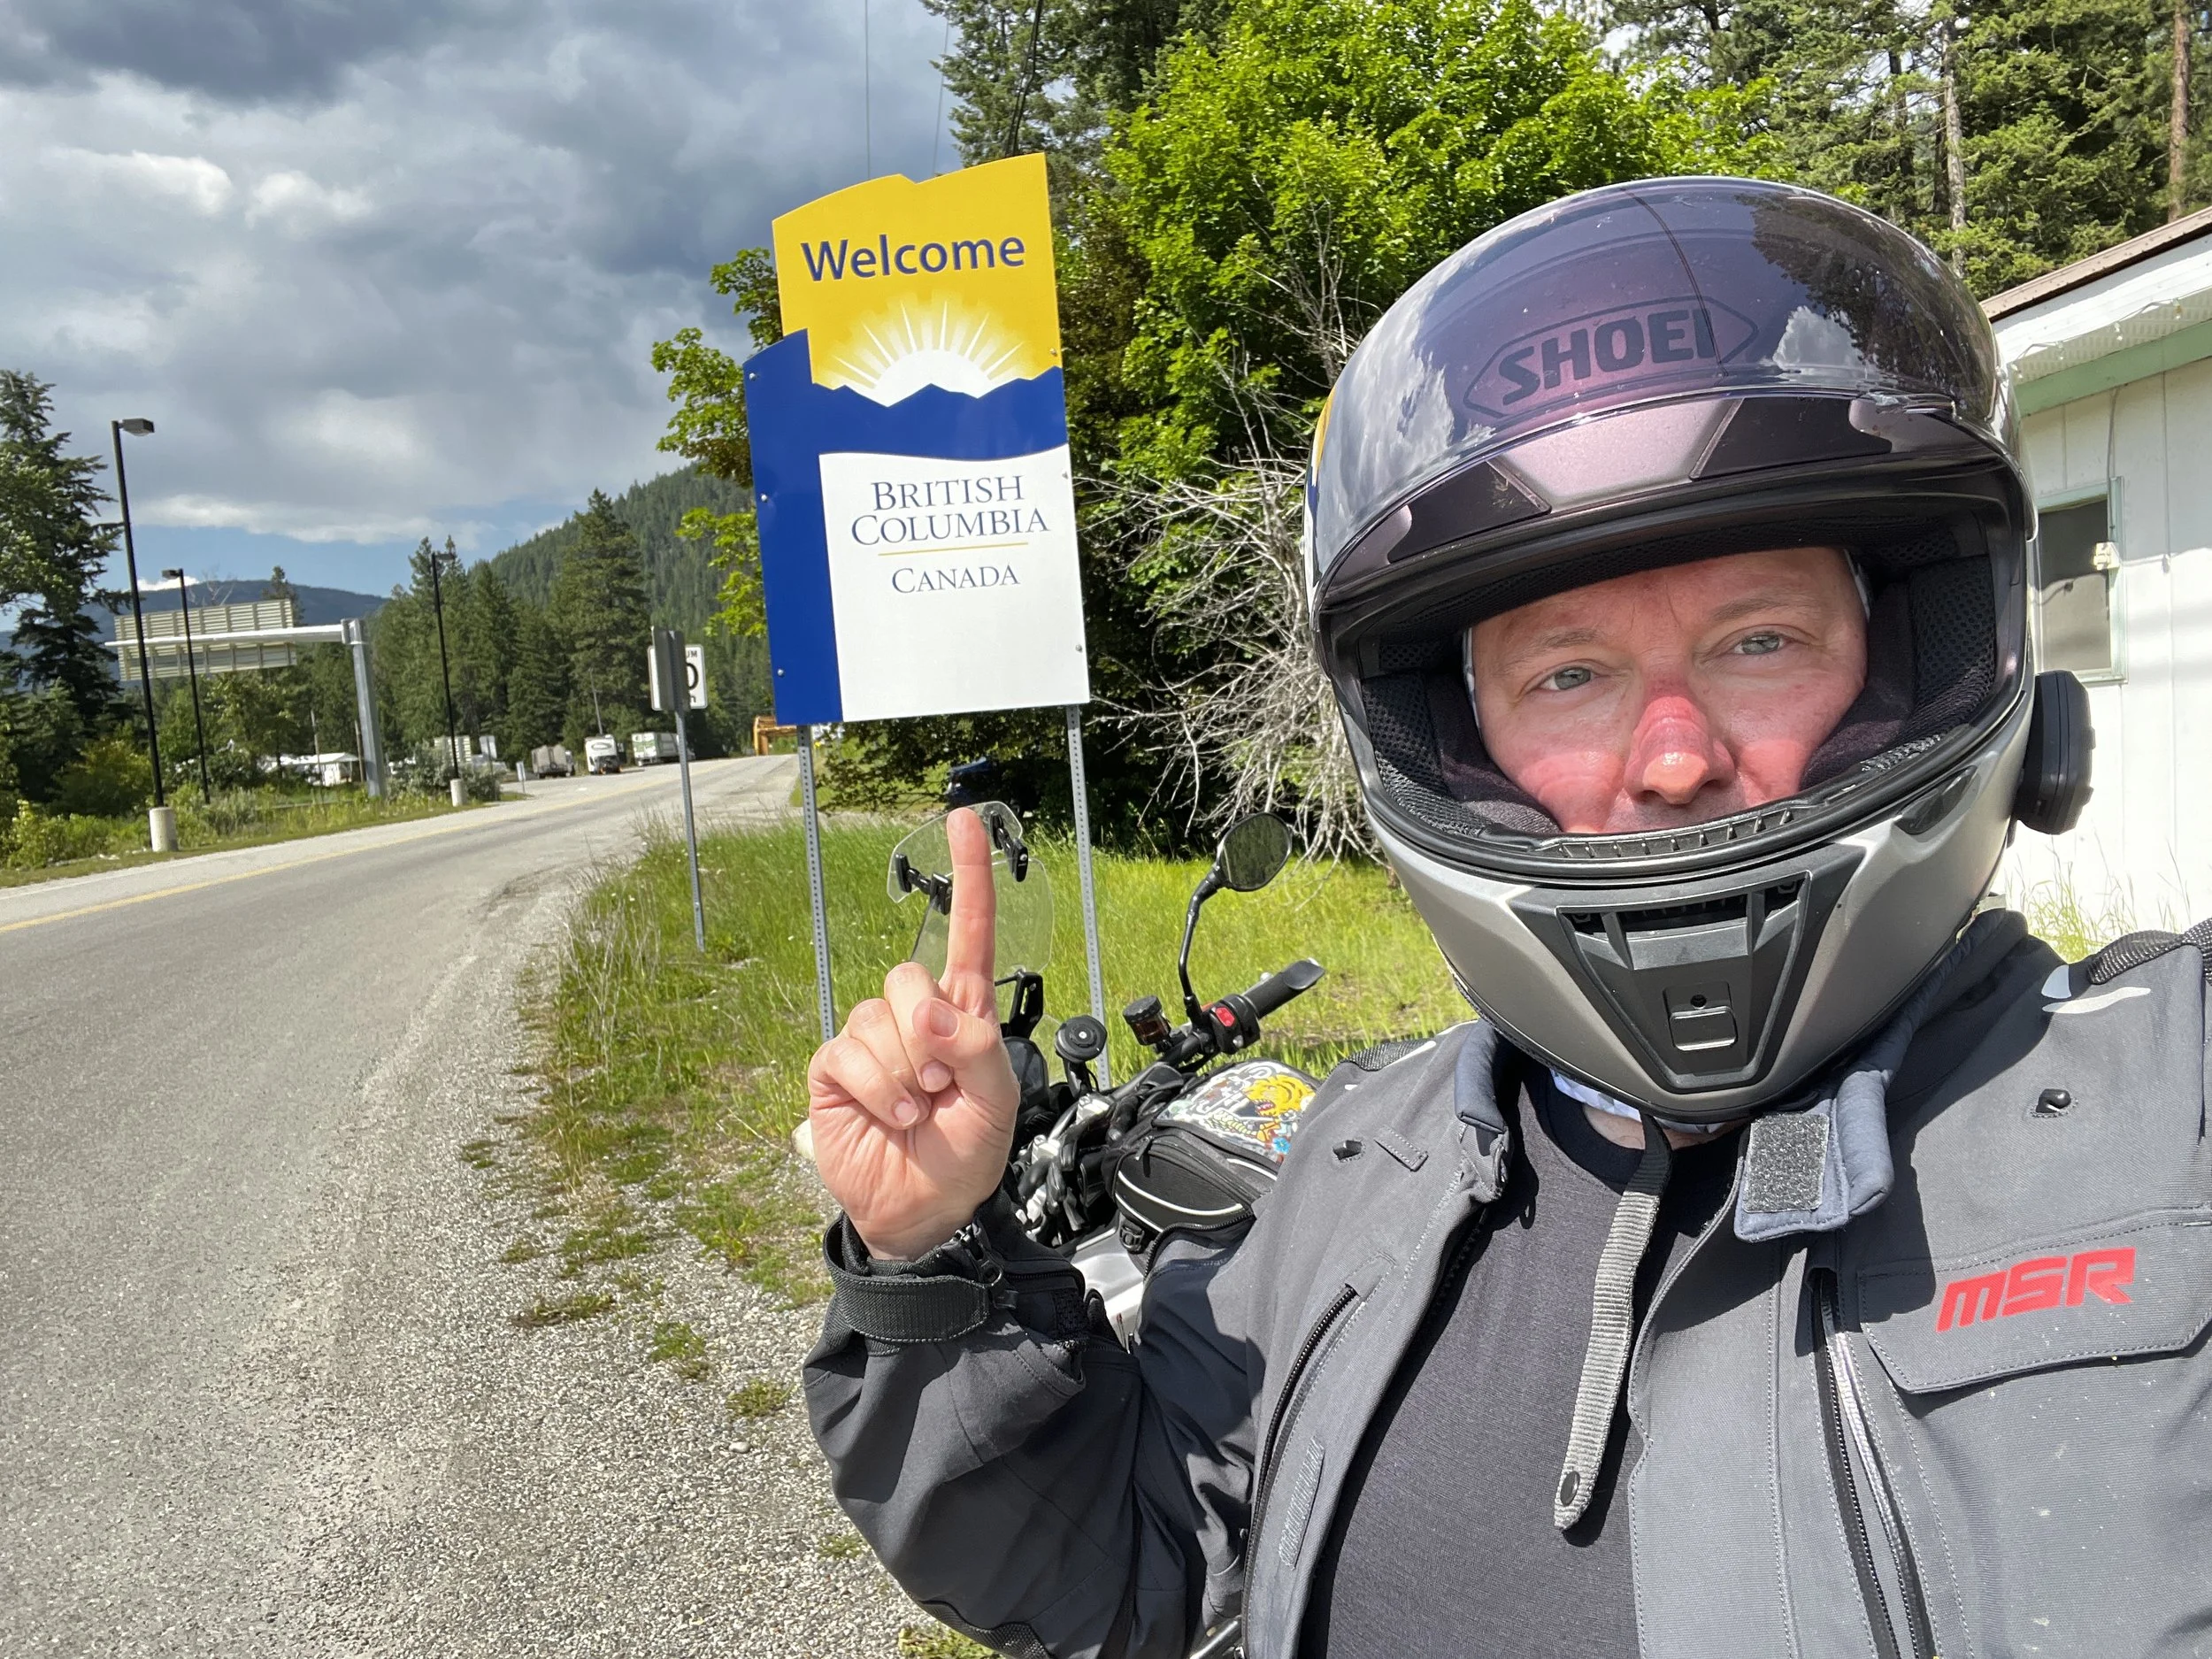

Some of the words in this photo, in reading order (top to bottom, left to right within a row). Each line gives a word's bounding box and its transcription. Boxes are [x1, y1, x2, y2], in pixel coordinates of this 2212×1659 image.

[801, 234, 1025, 282] Welcome
[1498, 308, 1717, 406] SHOEI
[871, 475, 1025, 511] BRITISH
[851, 508, 1051, 546] COLUMBIA
[891, 564, 1020, 595] CANADA
[1935, 1248, 2136, 1333] MSR
